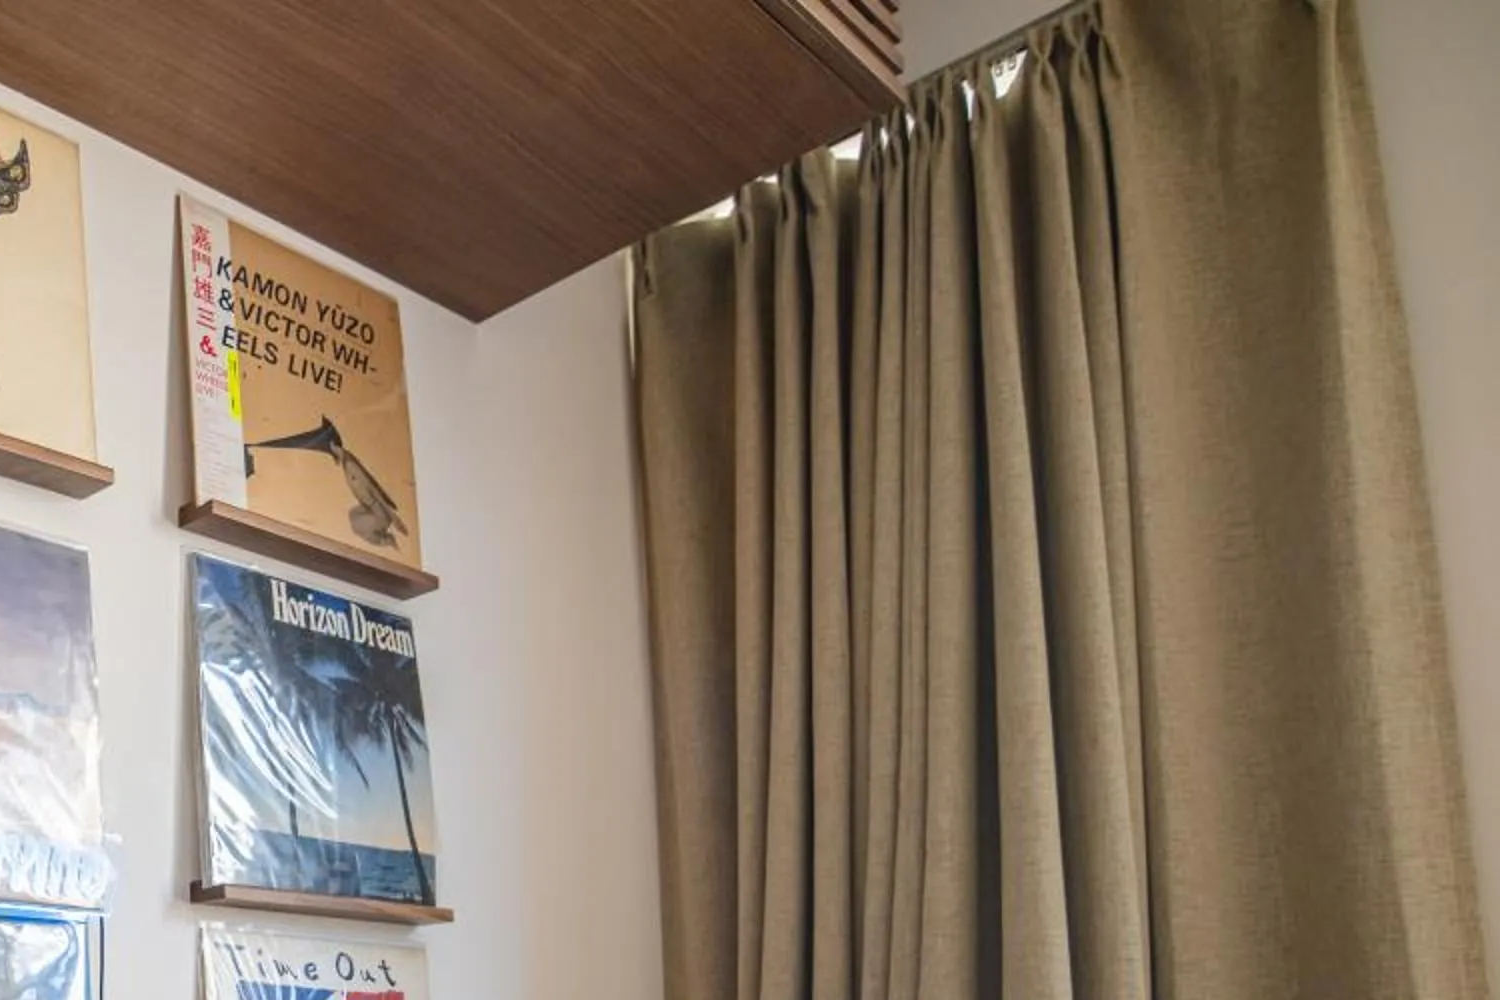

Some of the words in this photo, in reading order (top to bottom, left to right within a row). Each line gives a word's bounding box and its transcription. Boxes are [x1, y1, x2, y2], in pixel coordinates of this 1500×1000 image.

[216, 256, 308, 314] KAMON
[218, 288, 234, 312] &
[237, 297, 325, 353] VICTOR
[333, 339, 377, 375] WH-
[221, 325, 278, 366] EELS
[288, 354, 343, 394] LIVE!
[272, 578, 350, 642] Horizon
[350, 603, 415, 660] Dream
[213, 941, 319, 982] Time
[335, 951, 398, 988] Out
